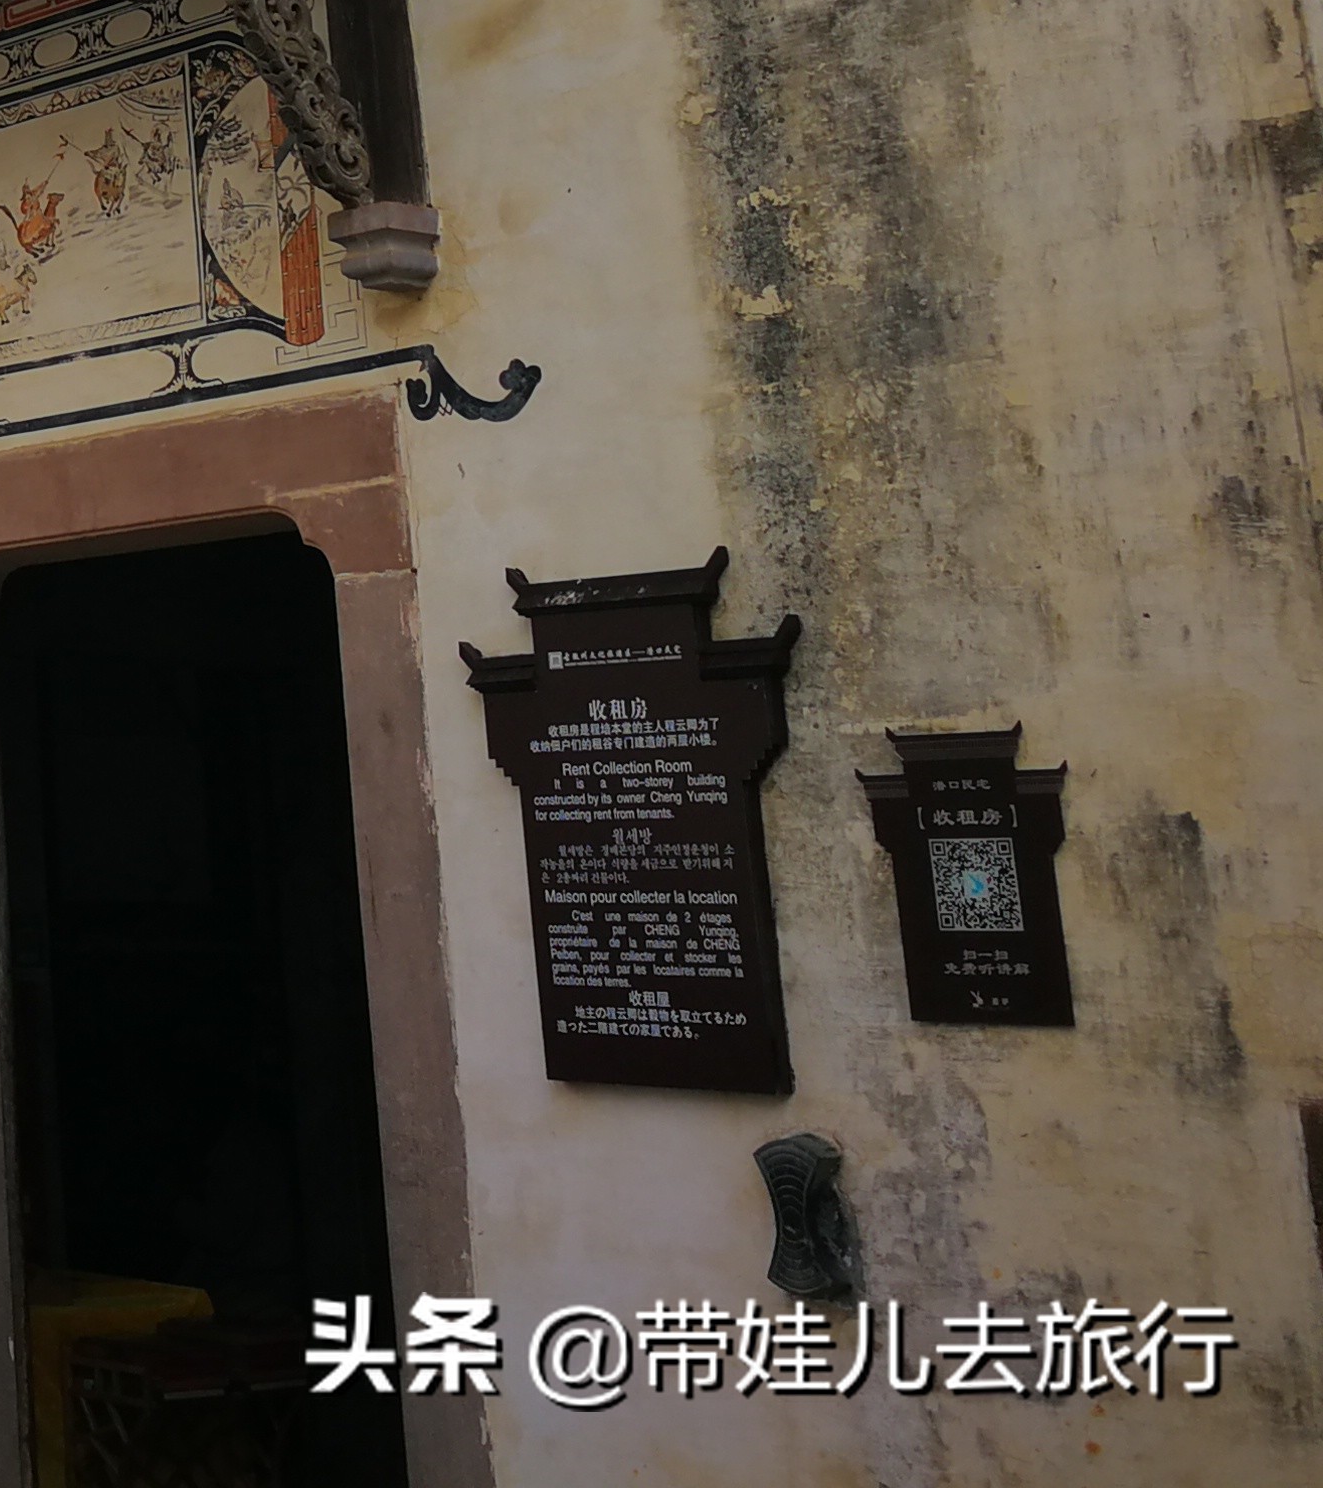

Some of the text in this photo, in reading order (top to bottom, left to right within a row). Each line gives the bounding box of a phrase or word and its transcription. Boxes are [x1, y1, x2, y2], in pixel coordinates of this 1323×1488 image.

[588, 697, 648, 721] 收租房
[562, 759, 692, 777] Rent Collection Room
[554, 774, 726, 790] It is a two-storey building
[534, 790, 728, 807] constructed by its owner Cheng Yunqing
[535, 807, 674, 823] for collecting rent from tenants.
[544, 889, 738, 906] Maison pour collecter la location
[571, 910, 593, 922] C'est
[605, 912, 621, 922] une
[628, 911, 659, 922] maison
[666, 911, 678, 923] de
[684, 912, 691, 923] 2
[548, 924, 588, 935] construite
[612, 926, 626, 937] par
[644, 924, 680, 936] CHENG
[549, 936, 741, 951] propriétaire de la maison de CHENG
[590, 951, 609, 963] pour
[620, 951, 656, 962] collecter
[684, 952, 717, 963] stocker
[728, 953, 742, 964] les
[616, 965, 630, 977] par
[634, 964, 647, 975] les
[653, 965, 696, 976] locataires
[698, 966, 731, 978] comme
[735, 966, 744, 978] la
[553, 974, 585, 985] location
[587, 976, 602, 987] des
